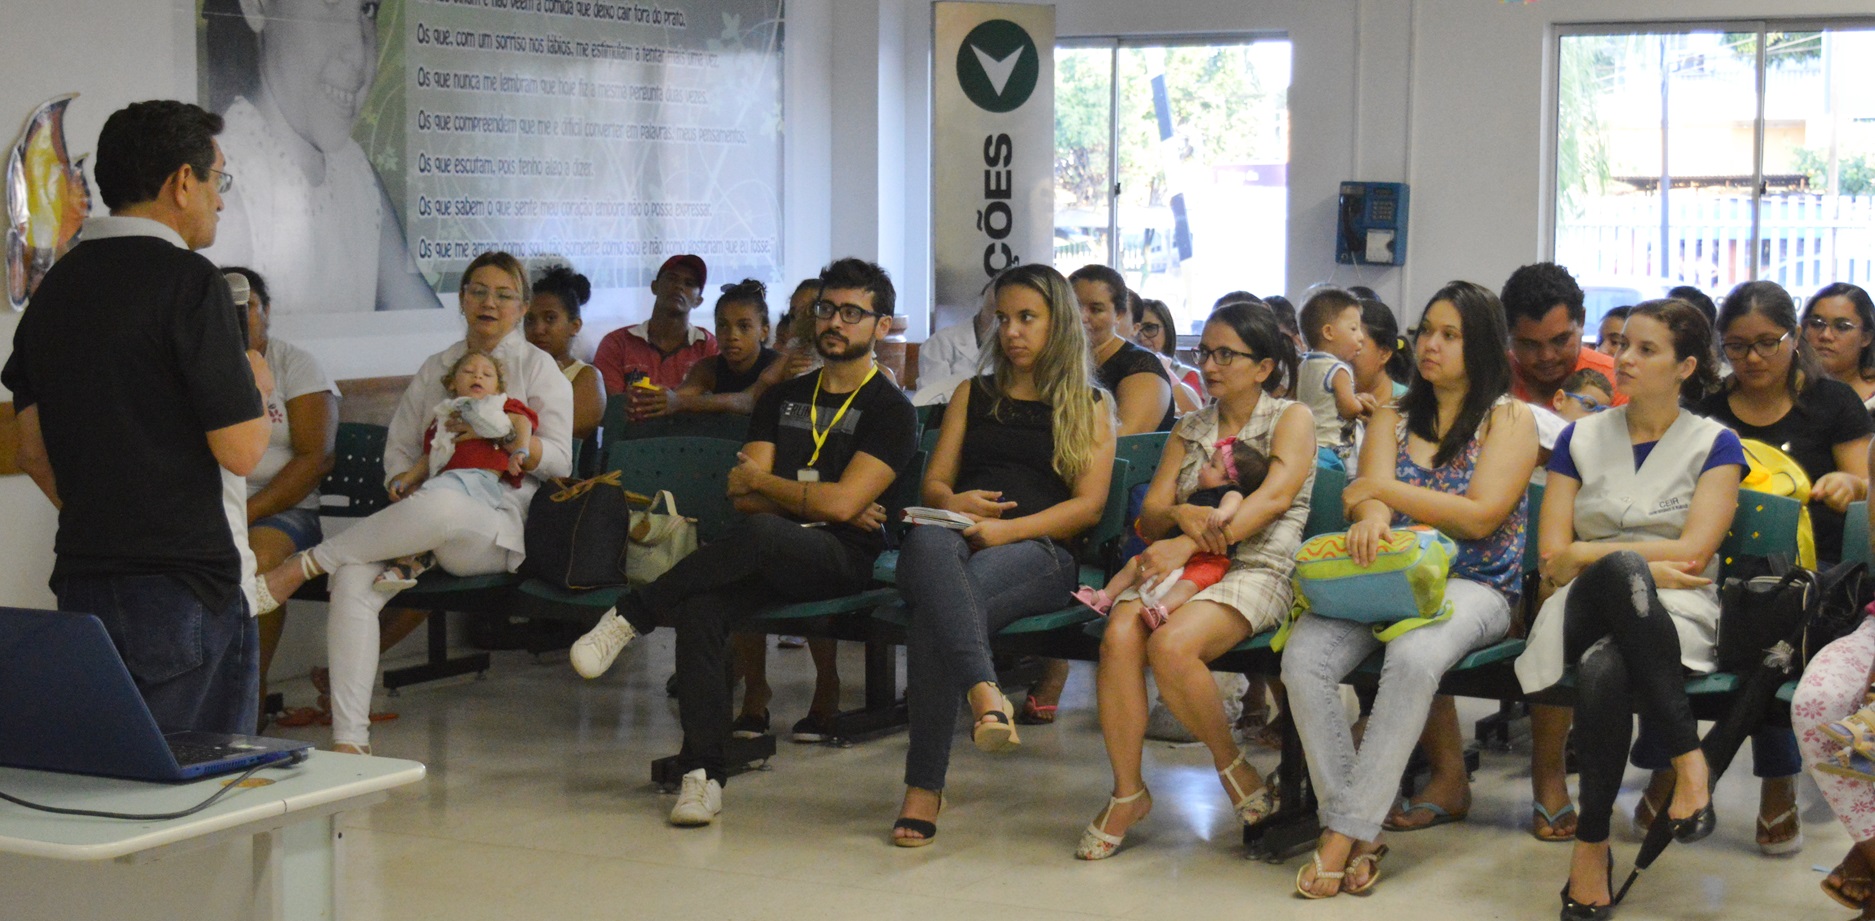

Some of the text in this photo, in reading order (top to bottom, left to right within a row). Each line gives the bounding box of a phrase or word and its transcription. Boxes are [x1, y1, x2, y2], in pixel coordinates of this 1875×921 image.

[544, 0, 574, 15] comida
[576, 1, 591, 17] que
[593, 0, 614, 19] deixo
[617, 3, 632, 21] cair
[634, 4, 650, 23] fora
[652, 6, 661, 24] do
[664, 9, 686, 27] prato.
[417, 22, 430, 44] Os
[456, 31, 475, 48] com
[478, 33, 492, 49] um
[495, 31, 526, 52] sorriso
[528, 37, 544, 54] nos
[576, 42, 589, 58] me
[591, 41, 632, 61] estimulam
[635, 47, 640, 62] a
[642, 45, 665, 64] tentar
[418, 66, 431, 87] Os
[433, 71, 451, 88] que
[453, 72, 480, 90] nunca
[483, 75, 497, 91] me
[500, 71, 538, 93] lembram
[541, 79, 556, 95] que
[558, 76, 576, 97] hoje
[579, 77, 588, 98] fiz
[590, 82, 595, 98] a
[598, 83, 626, 100] mesma
[629, 85, 663, 102] pergunta
[665, 85, 683, 103] duas
[418, 109, 431, 130] Os
[433, 114, 451, 131] que
[454, 112, 517, 133] compreendem
[520, 119, 535, 134] que
[537, 120, 551, 135] me
[585, 122, 624, 138] converter
[626, 124, 638, 139] em
[677, 127, 697, 142] meus
[419, 152, 432, 173] Os
[434, 157, 451, 174] que
[498, 156, 515, 175] pois
[518, 156, 542, 175] tenho
[545, 157, 563, 176] algo
[565, 161, 570, 176] a
[572, 157, 594, 177] dizer.
[419, 195, 712, 221] Os que sabem o que sente meu coração embora não o possa expressar.
[419, 239, 432, 258] Os
[435, 242, 452, 258] que
[455, 243, 469, 258] me
[502, 242, 525, 257] como
[565, 240, 599, 257] somente
[601, 241, 623, 256] como
[626, 241, 640, 256] sou
[642, 241, 647, 256] e
[649, 236, 663, 256] não
[666, 241, 684, 255] como
[687, 238, 723, 255] gostariam
[725, 240, 738, 254] que
[740, 240, 748, 254] eu
[1658, 497, 1679, 509] CEIR
